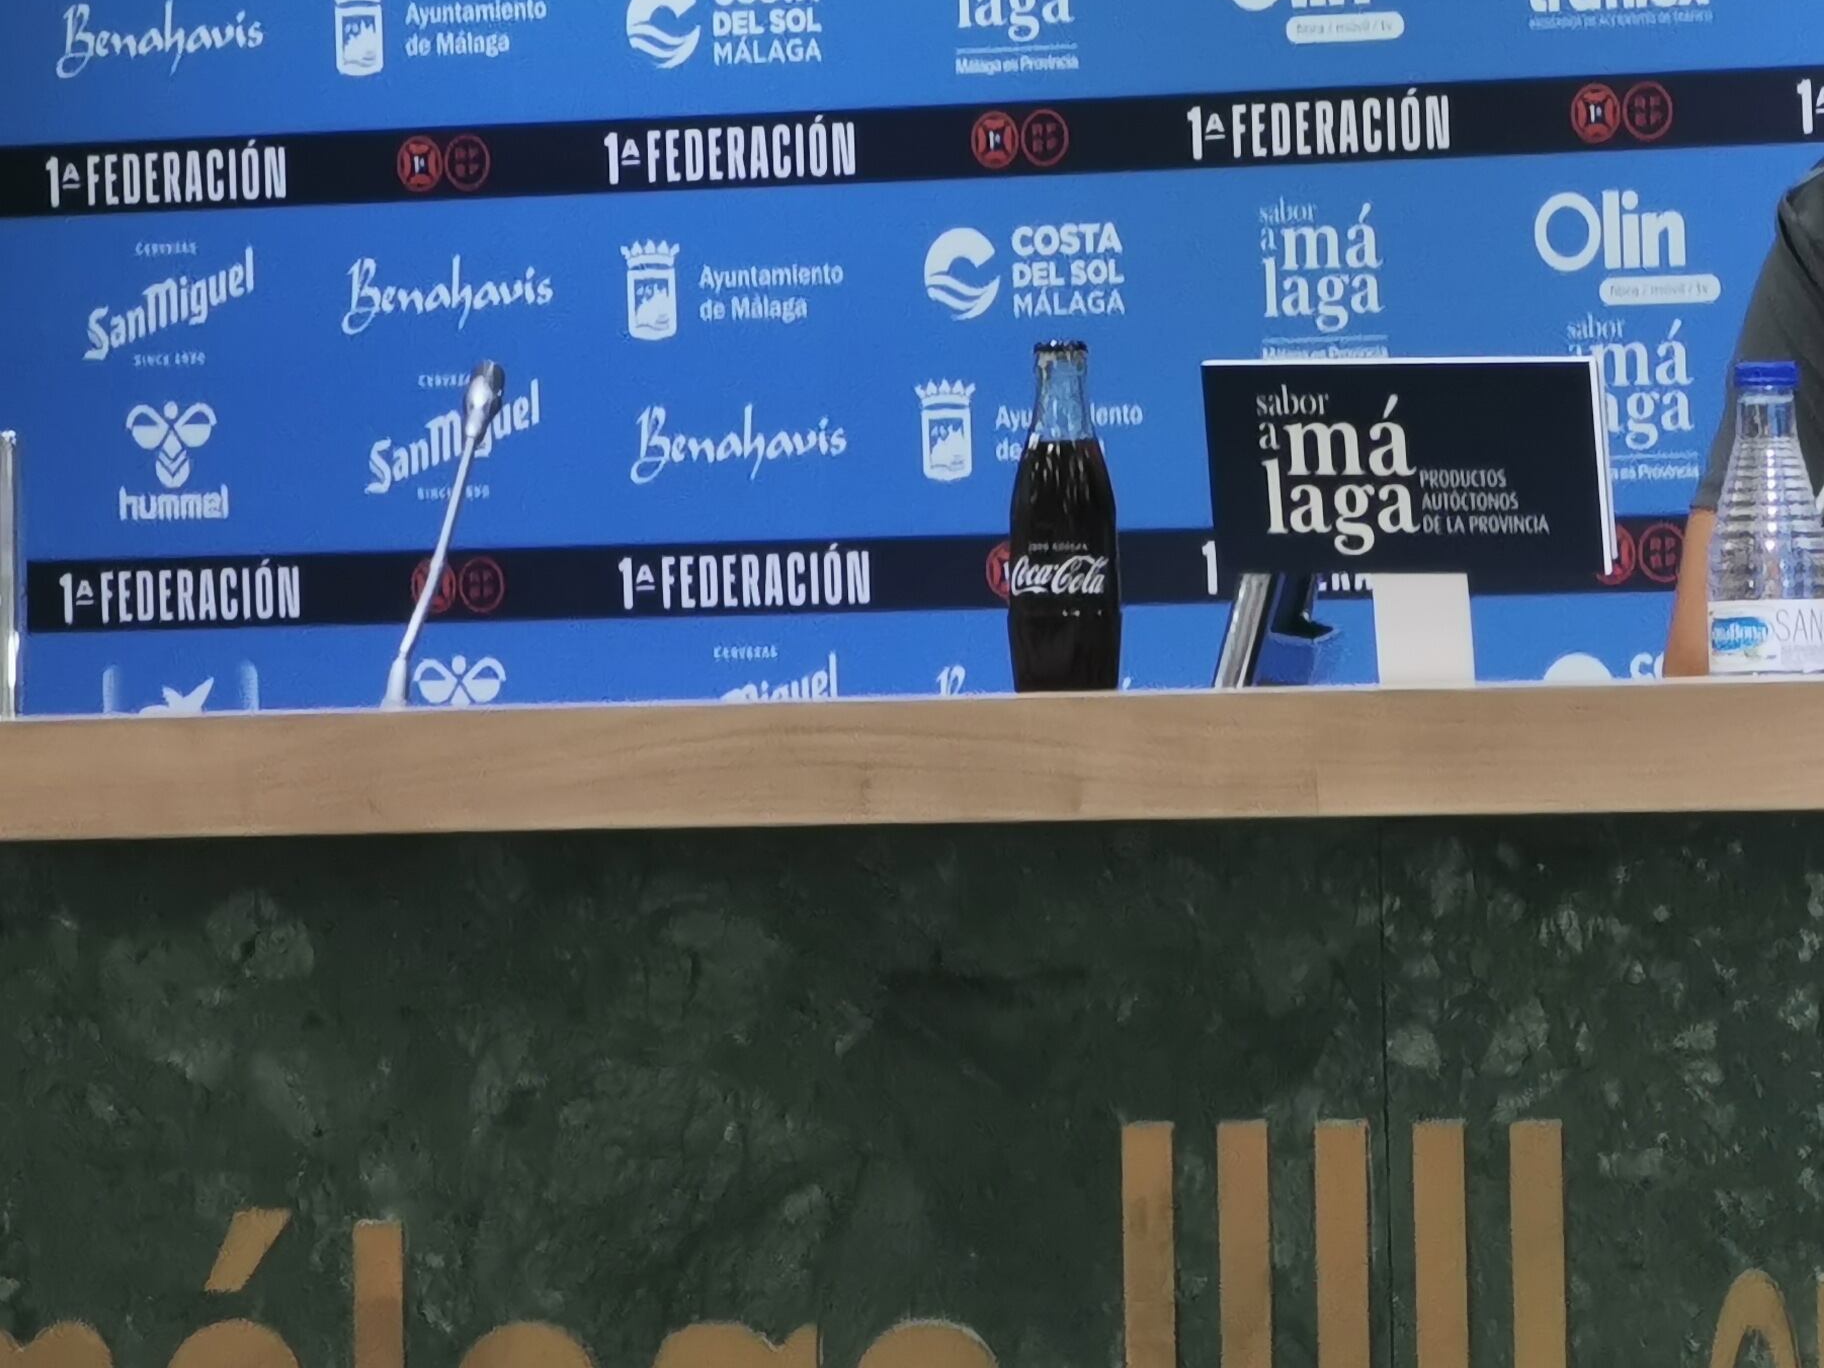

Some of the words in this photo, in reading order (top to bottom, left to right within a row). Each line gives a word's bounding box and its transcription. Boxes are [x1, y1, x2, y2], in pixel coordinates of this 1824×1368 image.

[712, 9, 765, 39] DEL
[769, 6, 822, 34] SOL
[713, 37, 822, 65] MÁLAGA
[1231, 87, 1450, 158] FEDERACIÓN
[646, 114, 856, 184] FEDERACIÓN
[86, 139, 287, 206] FEDERACIÓN
[1011, 221, 1123, 257] COSTA
[1534, 189, 1686, 272] Olin
[699, 263, 844, 294] Ayuntamiento
[1012, 261, 1065, 288] DEL
[1070, 258, 1125, 286] SOL
[699, 298, 726, 322] de
[731, 294, 808, 324] Málaga
[1013, 288, 1125, 316] MÁLAGA
[1256, 384, 1329, 417] sabor
[1258, 421, 1280, 450] a
[1283, 393, 1417, 477] má
[1419, 469, 1507, 488] PRODUCTOS
[119, 484, 229, 521] hummel
[1261, 457, 1421, 556] laga
[1422, 490, 1519, 512] AUTÓCTONOS
[1422, 515, 1443, 534] DE
[1447, 515, 1464, 534] LA
[1469, 514, 1550, 534] PROVINCIA
[100, 558, 301, 624] FEDERACIÓN
[661, 542, 871, 609] FEDERACIÓN
